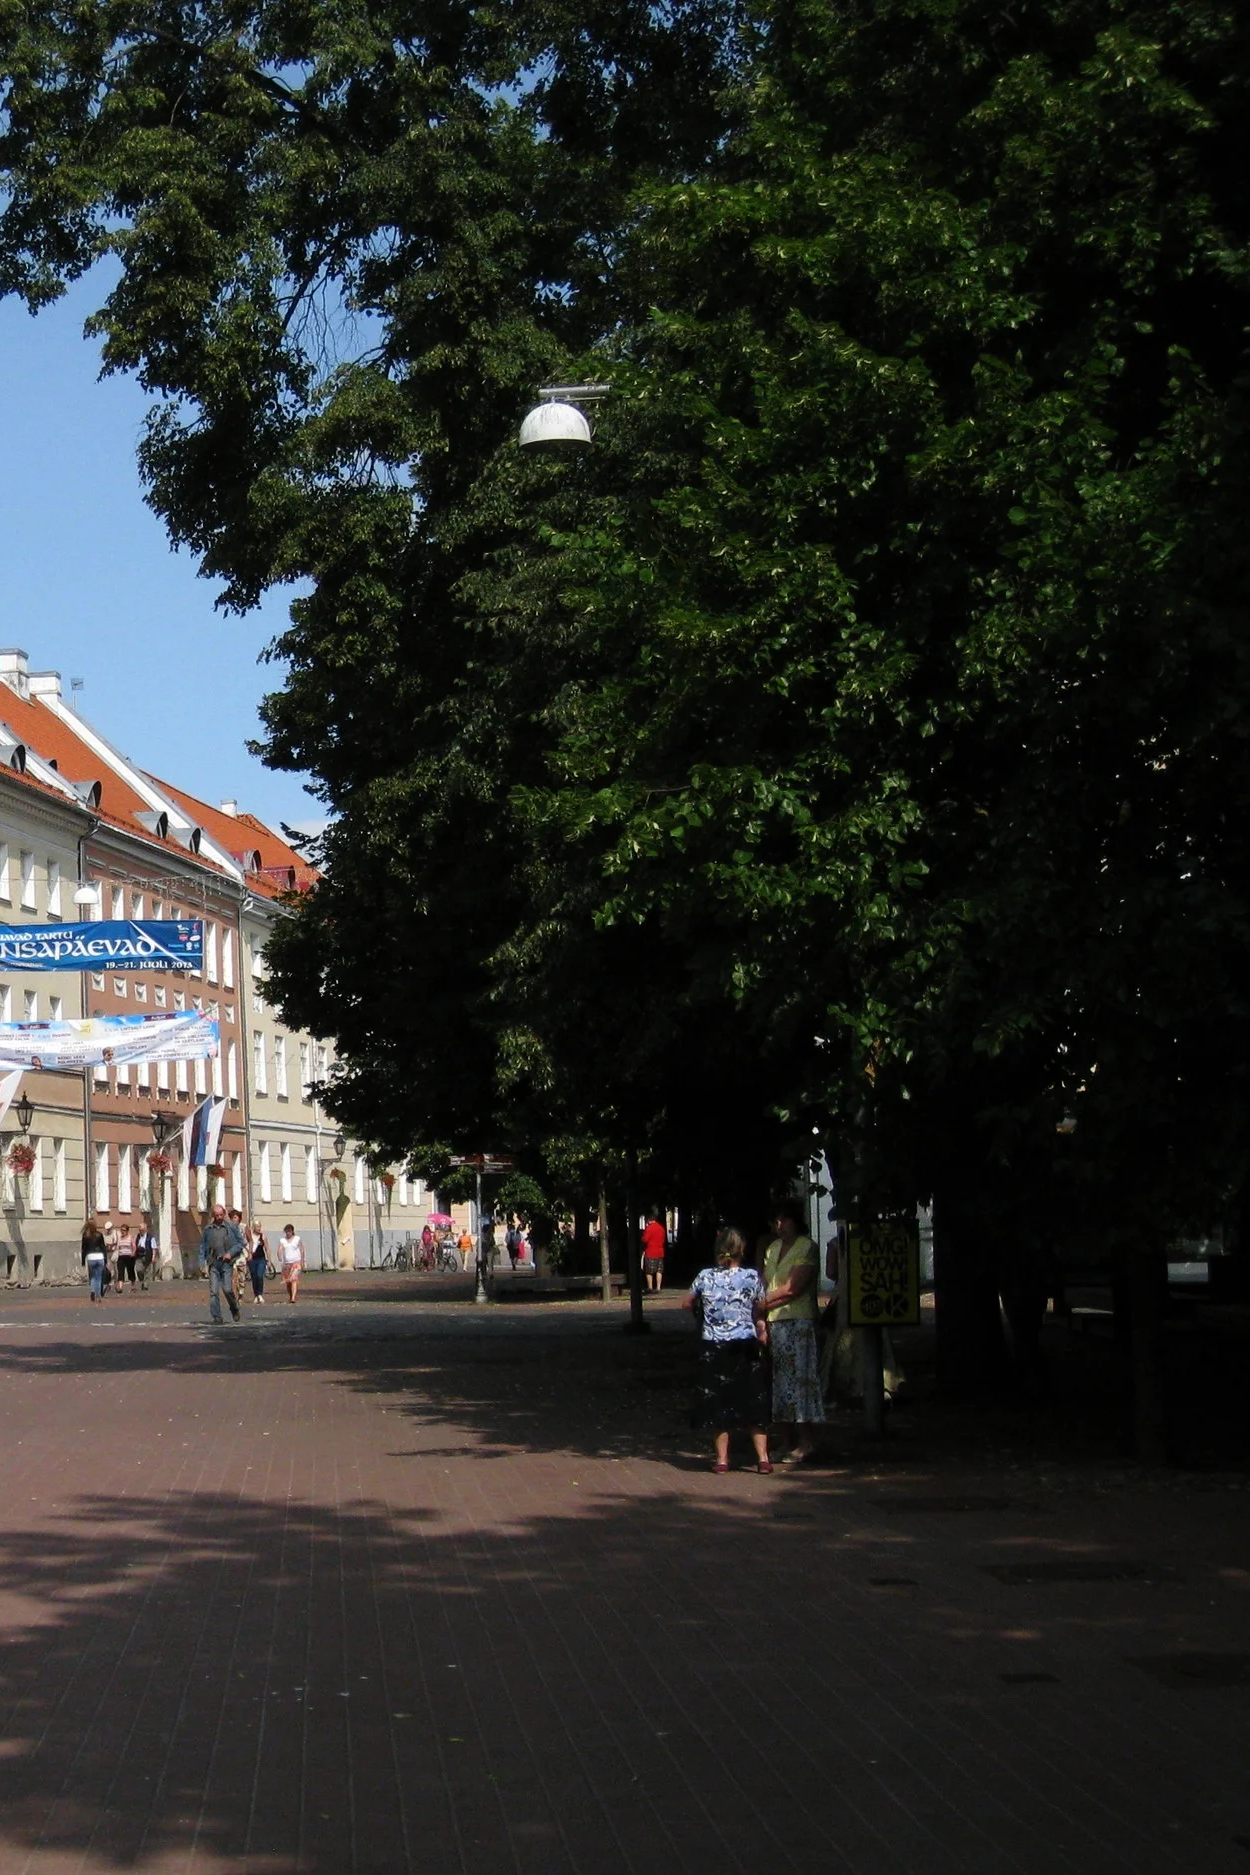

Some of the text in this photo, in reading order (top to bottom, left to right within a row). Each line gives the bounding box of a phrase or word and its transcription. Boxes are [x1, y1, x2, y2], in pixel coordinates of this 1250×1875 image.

[35, 931, 73, 941] TARTU
[859, 1237, 908, 1255] OMG!
[860, 1256, 908, 1271] WOW!
[860, 1272, 908, 1293] SAH!
